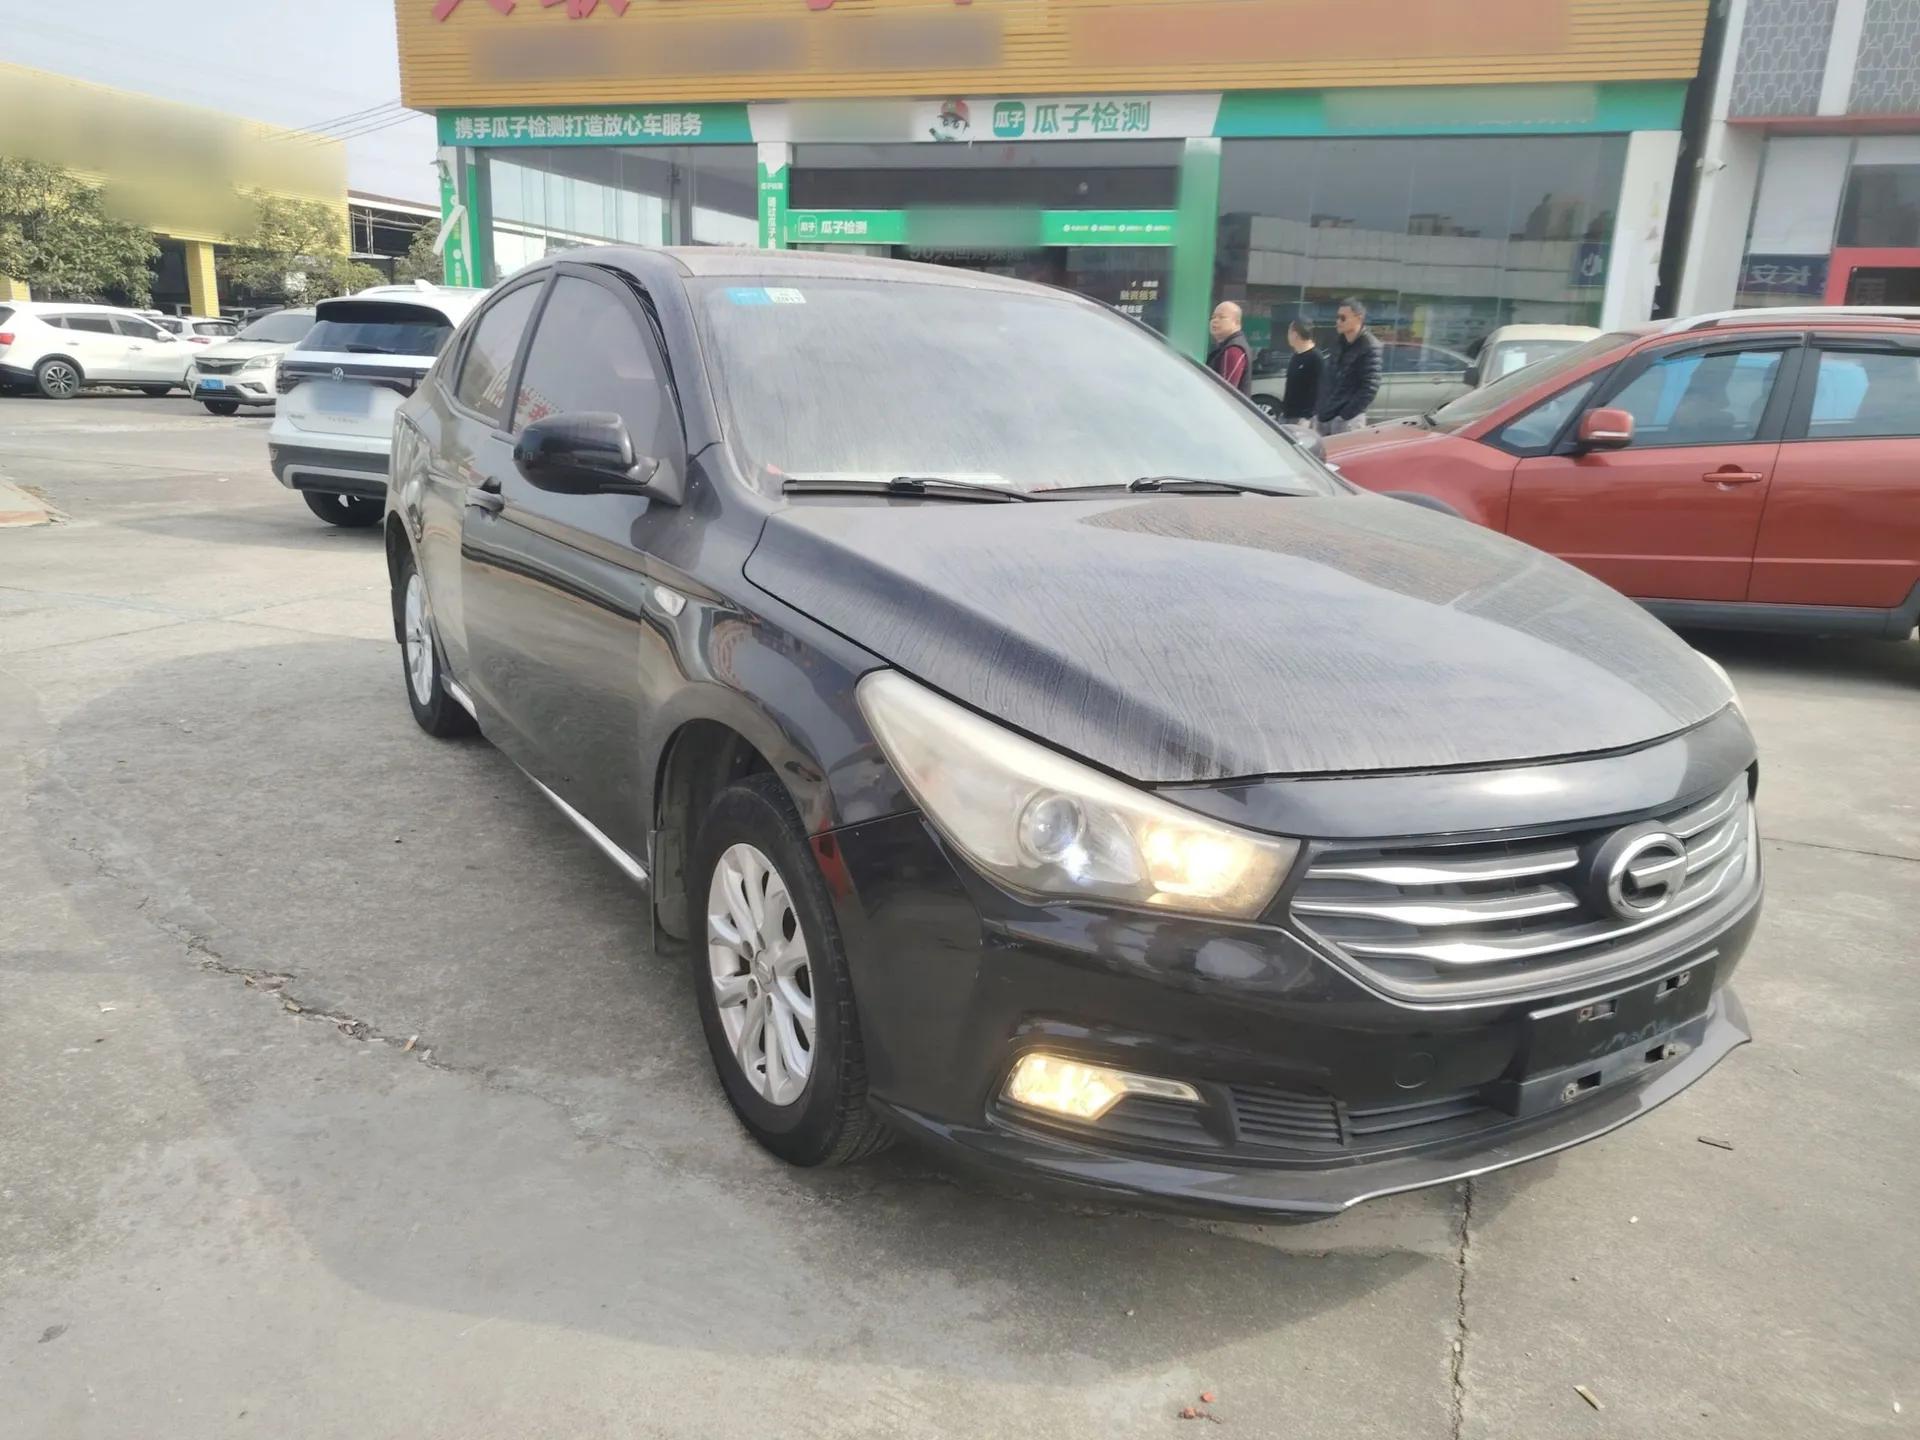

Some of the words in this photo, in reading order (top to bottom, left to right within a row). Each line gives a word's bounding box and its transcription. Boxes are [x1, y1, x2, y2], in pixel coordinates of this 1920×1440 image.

[455, 112, 702, 140] 携手瓜子检测打造放心车服务
[995, 111, 1024, 128] 瓜子
[1032, 101, 1152, 133] 瓜子检测
[820, 220, 868, 234] 瓜子检测
